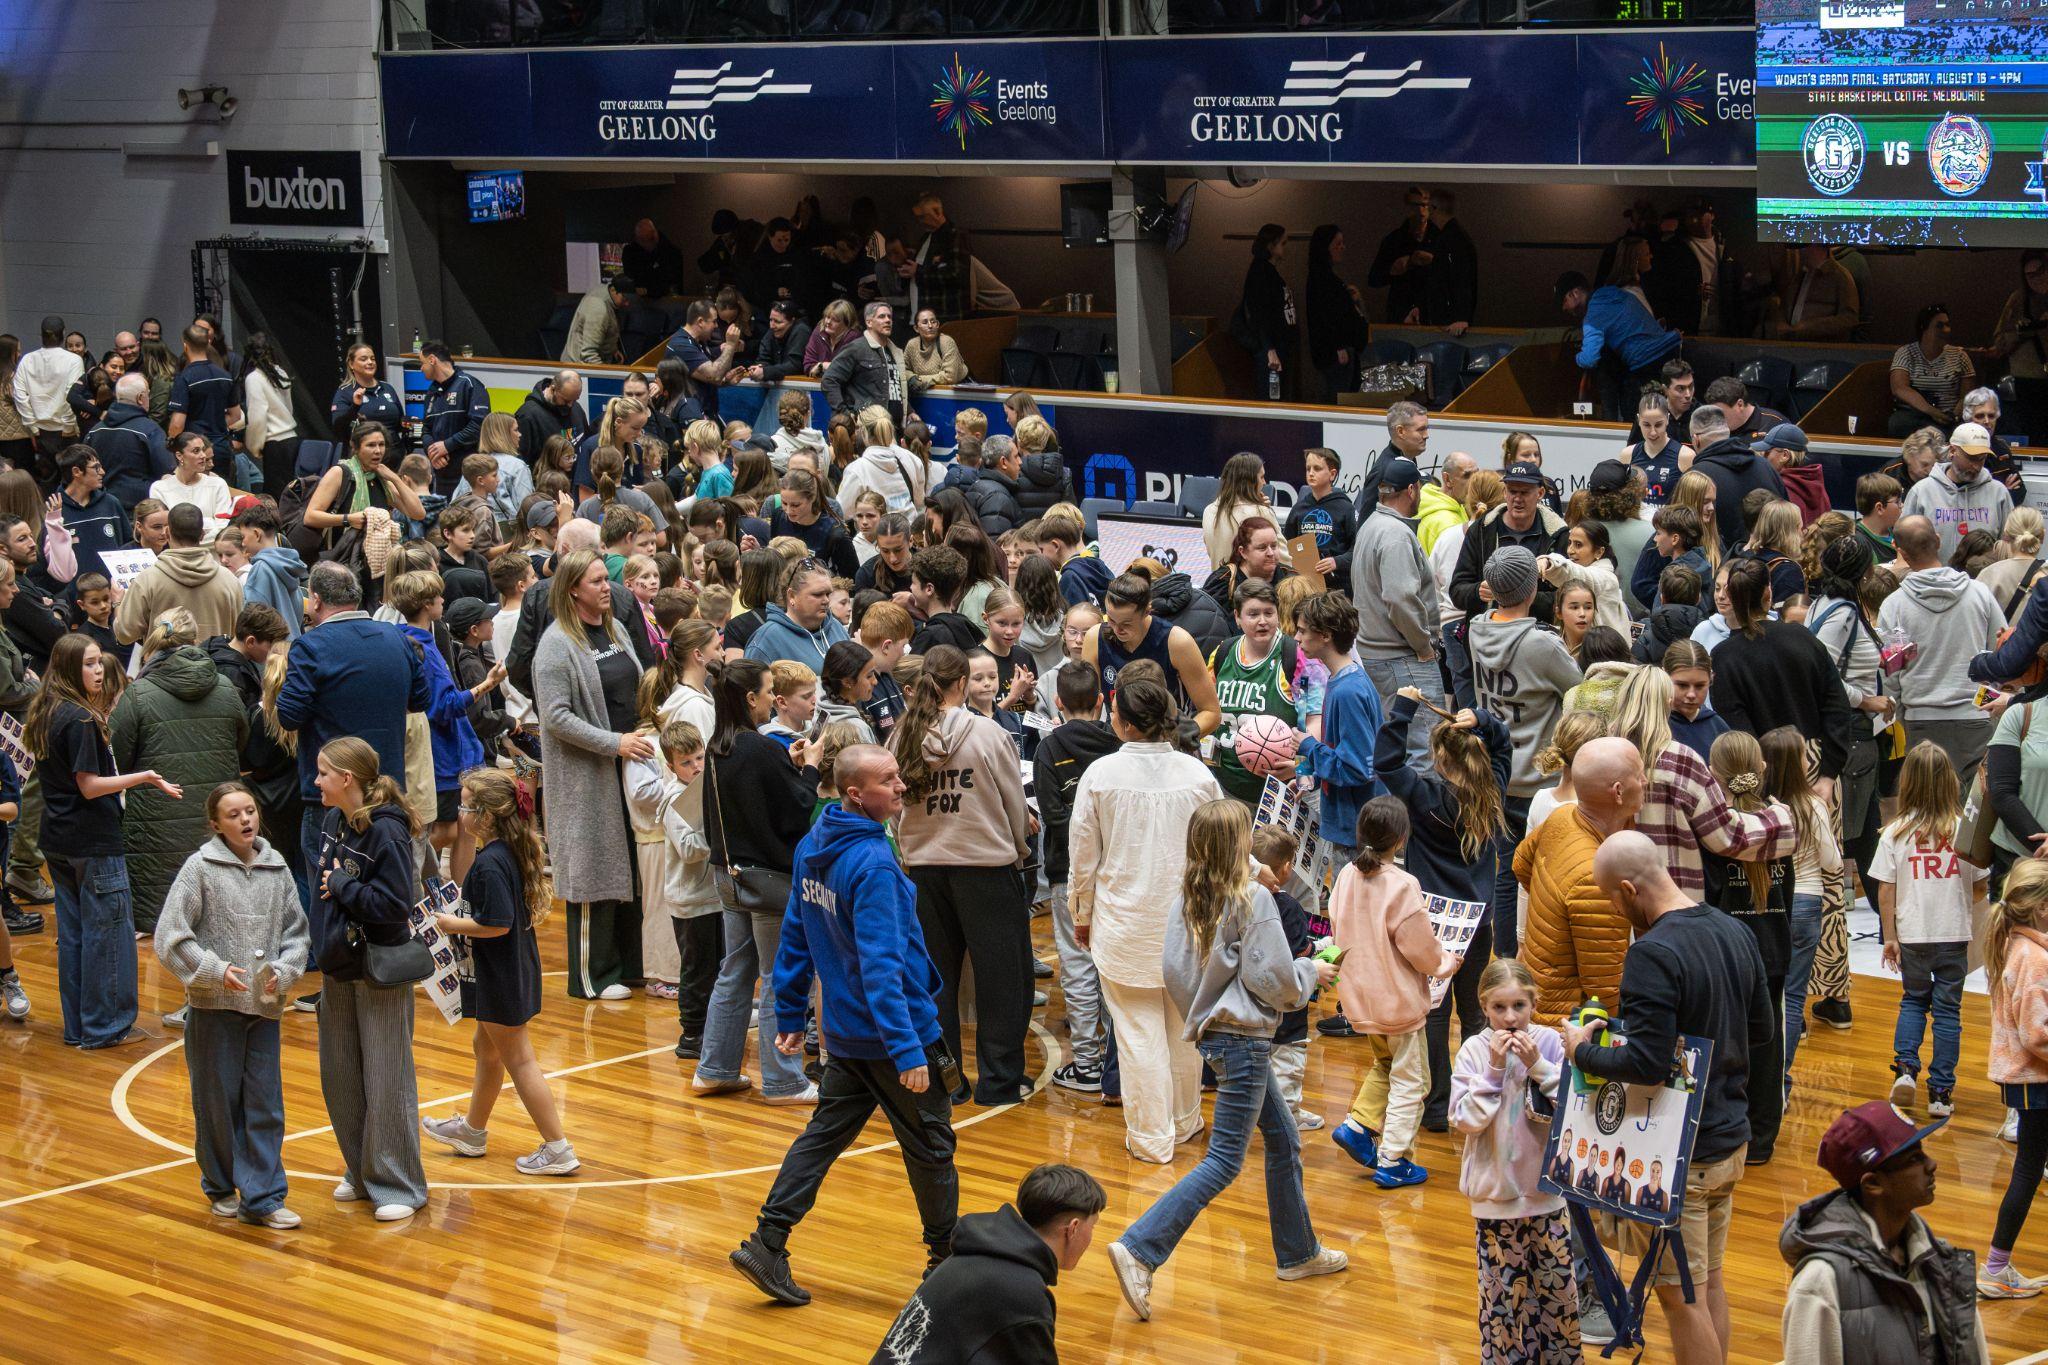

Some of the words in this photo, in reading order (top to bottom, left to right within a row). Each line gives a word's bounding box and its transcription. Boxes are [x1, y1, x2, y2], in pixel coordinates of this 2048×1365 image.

[998, 79, 1048, 100] Events
[1775, 73, 1817, 86] WOMEN'S
[1819, 73, 1849, 86] GRAND
[1852, 73, 1880, 86] FINAL:
[1882, 73, 1934, 86] SATURDAY,
[1936, 72, 1973, 85] AUGUST
[1999, 72, 2022, 84] 4PM
[600, 100, 616, 110] CITY
[617, 100, 628, 110] OF
[629, 100, 664, 110] GREATER
[1193, 96, 1217, 107] CITY
[1218, 96, 1231, 107] OF
[1232, 96, 1276, 107] GREATER
[1808, 91, 1836, 102] STATE
[1838, 91, 1892, 102] BASKETBALL
[1933, 90, 1985, 102] MELBOURNE
[998, 100, 1057, 125] Geelong
[598, 114, 717, 141] GEELONG
[1190, 112, 1344, 142] GEELONG
[1882, 141, 1911, 166] VS
[244, 165, 346, 210] buxton
[1315, 523, 1334, 532] GIANTS
[1935, 507, 1964, 524] PIVOT
[1967, 507, 1990, 524] CITY
[1217, 679, 1268, 712] CELTICS
[926, 793, 963, 816] FOX
[1913, 830, 1954, 854] EX
[1907, 854, 1962, 880] TRA
[801, 877, 837, 916] SECURITY
